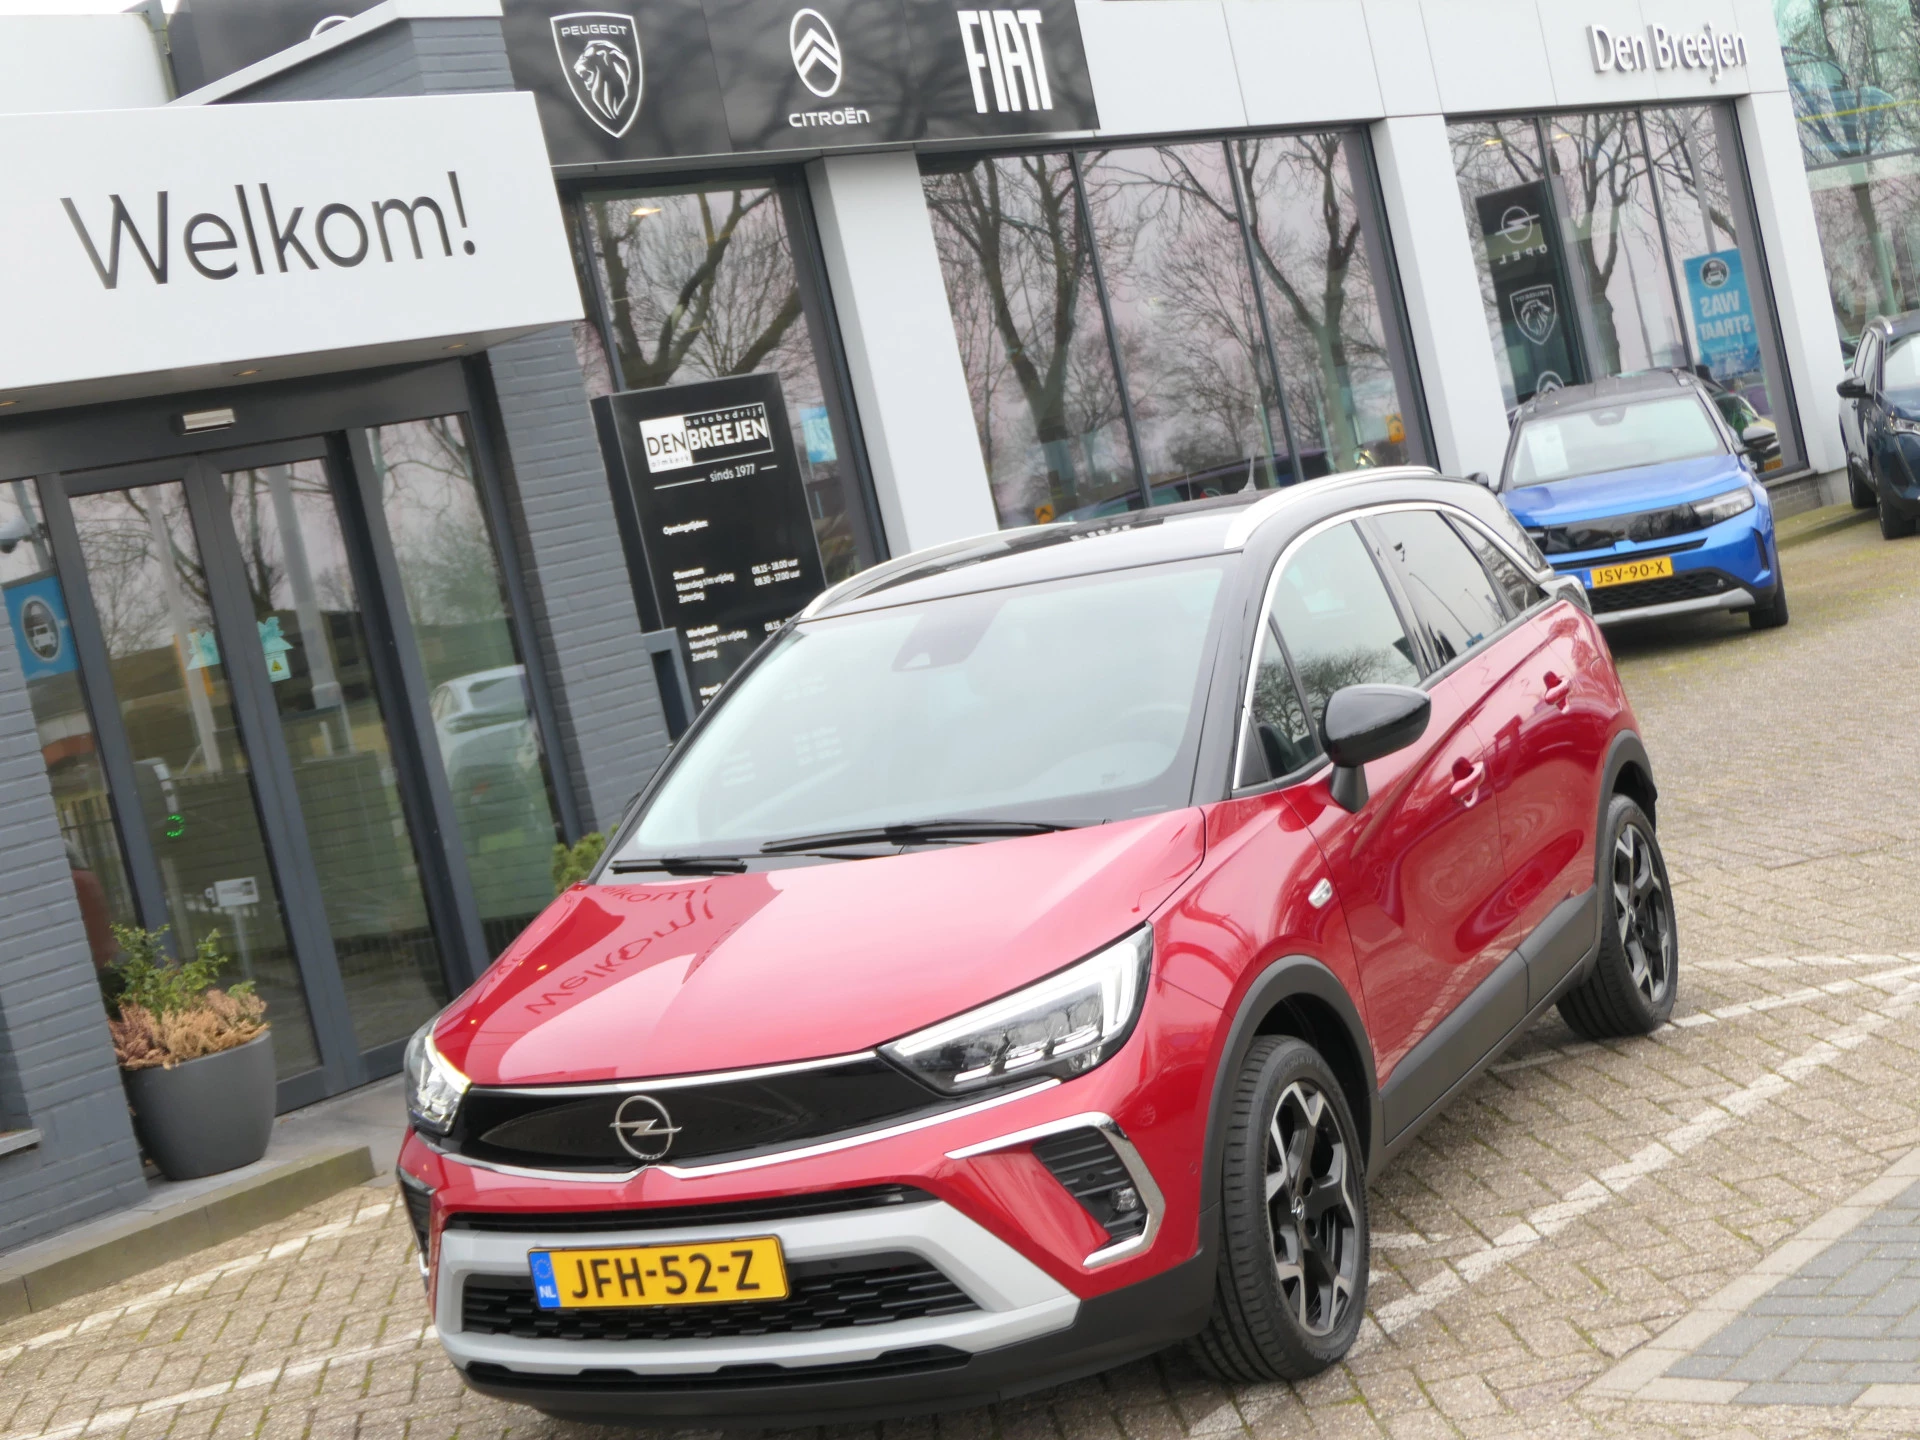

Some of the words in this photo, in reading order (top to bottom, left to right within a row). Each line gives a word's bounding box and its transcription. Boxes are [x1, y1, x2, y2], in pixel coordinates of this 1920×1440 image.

[561, 24, 627, 37] PEUGEOT
[957, 10, 1053, 113] FIAT
[1586, 23, 1650, 73] Den
[1647, 22, 1749, 84] Breejen
[60, 171, 476, 289] Welkom!
[685, 406, 763, 427] autobedrijf
[646, 431, 687, 456] DEN
[687, 417, 769, 451] BREEJEN
[709, 469, 735, 483] sinds
[735, 463, 756, 478] 1977
[1596, 560, 1665, 585] JSV-90-X
[571, 1250, 761, 1299] JFH-52-Z
[539, 1285, 557, 1299] NL
